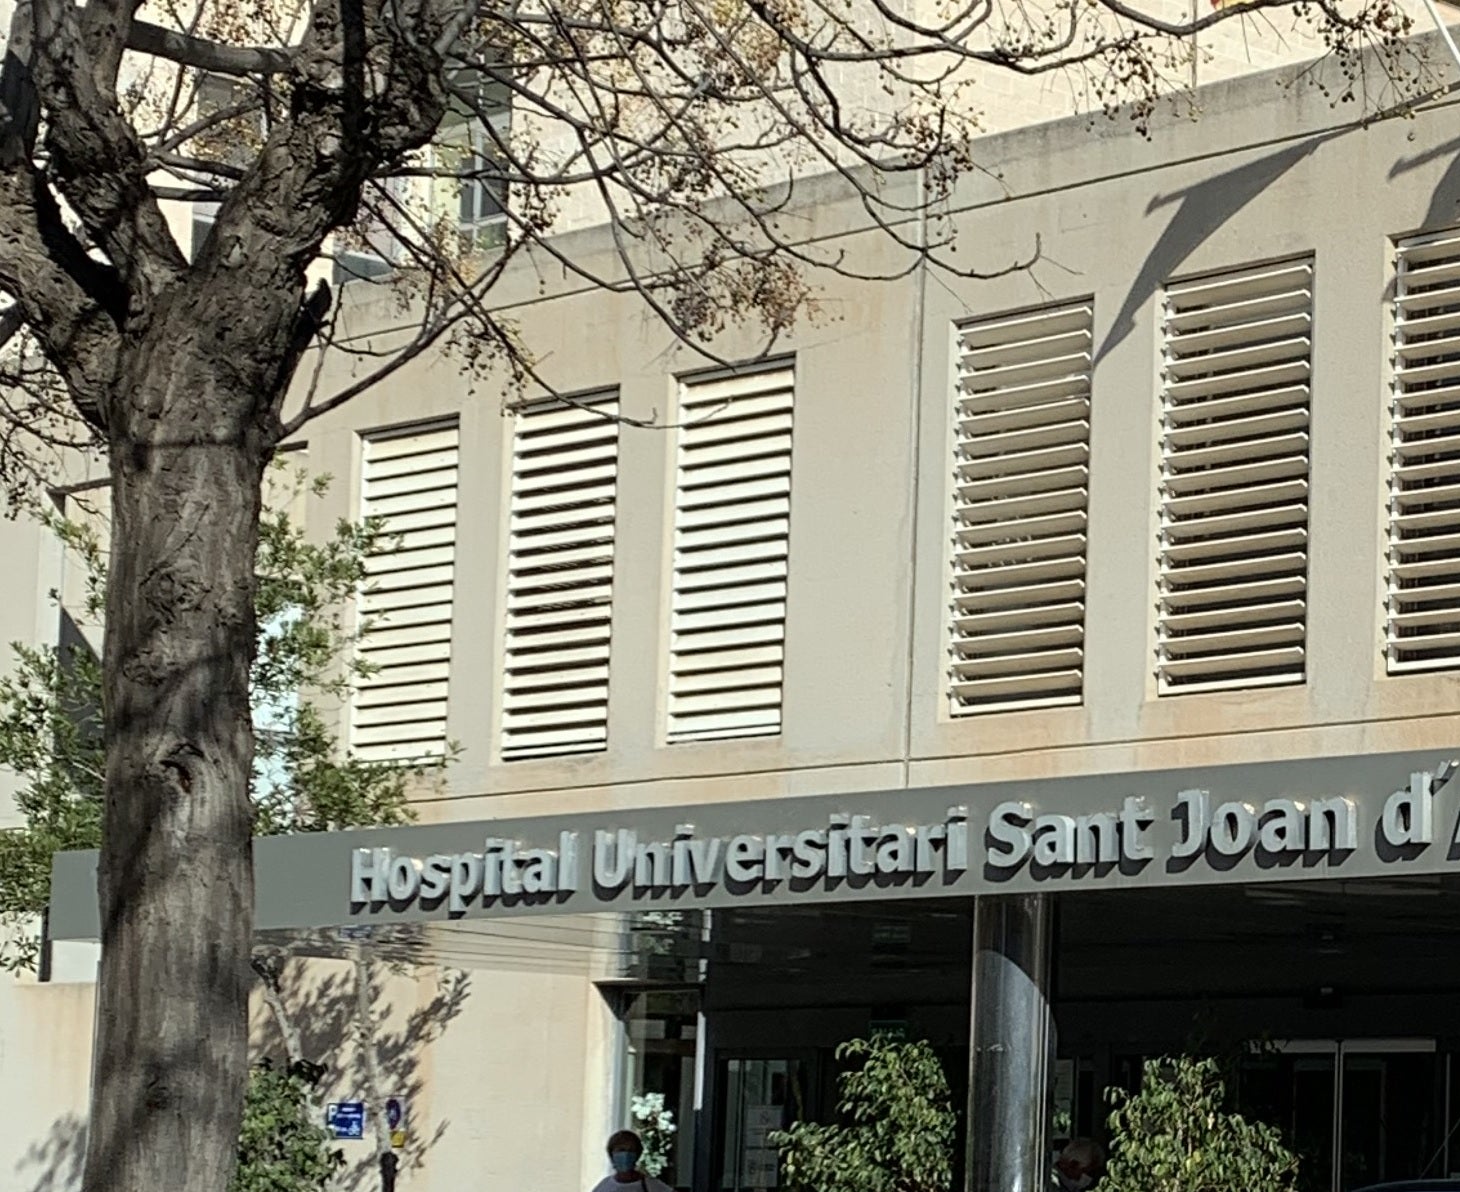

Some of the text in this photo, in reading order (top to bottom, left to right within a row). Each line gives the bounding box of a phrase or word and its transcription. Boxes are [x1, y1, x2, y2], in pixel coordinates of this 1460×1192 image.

[350, 829, 577, 918] Hospital
[592, 804, 969, 892] Universitari
[986, 801, 1154, 868] Sant
[1170, 789, 1357, 858] Joan
